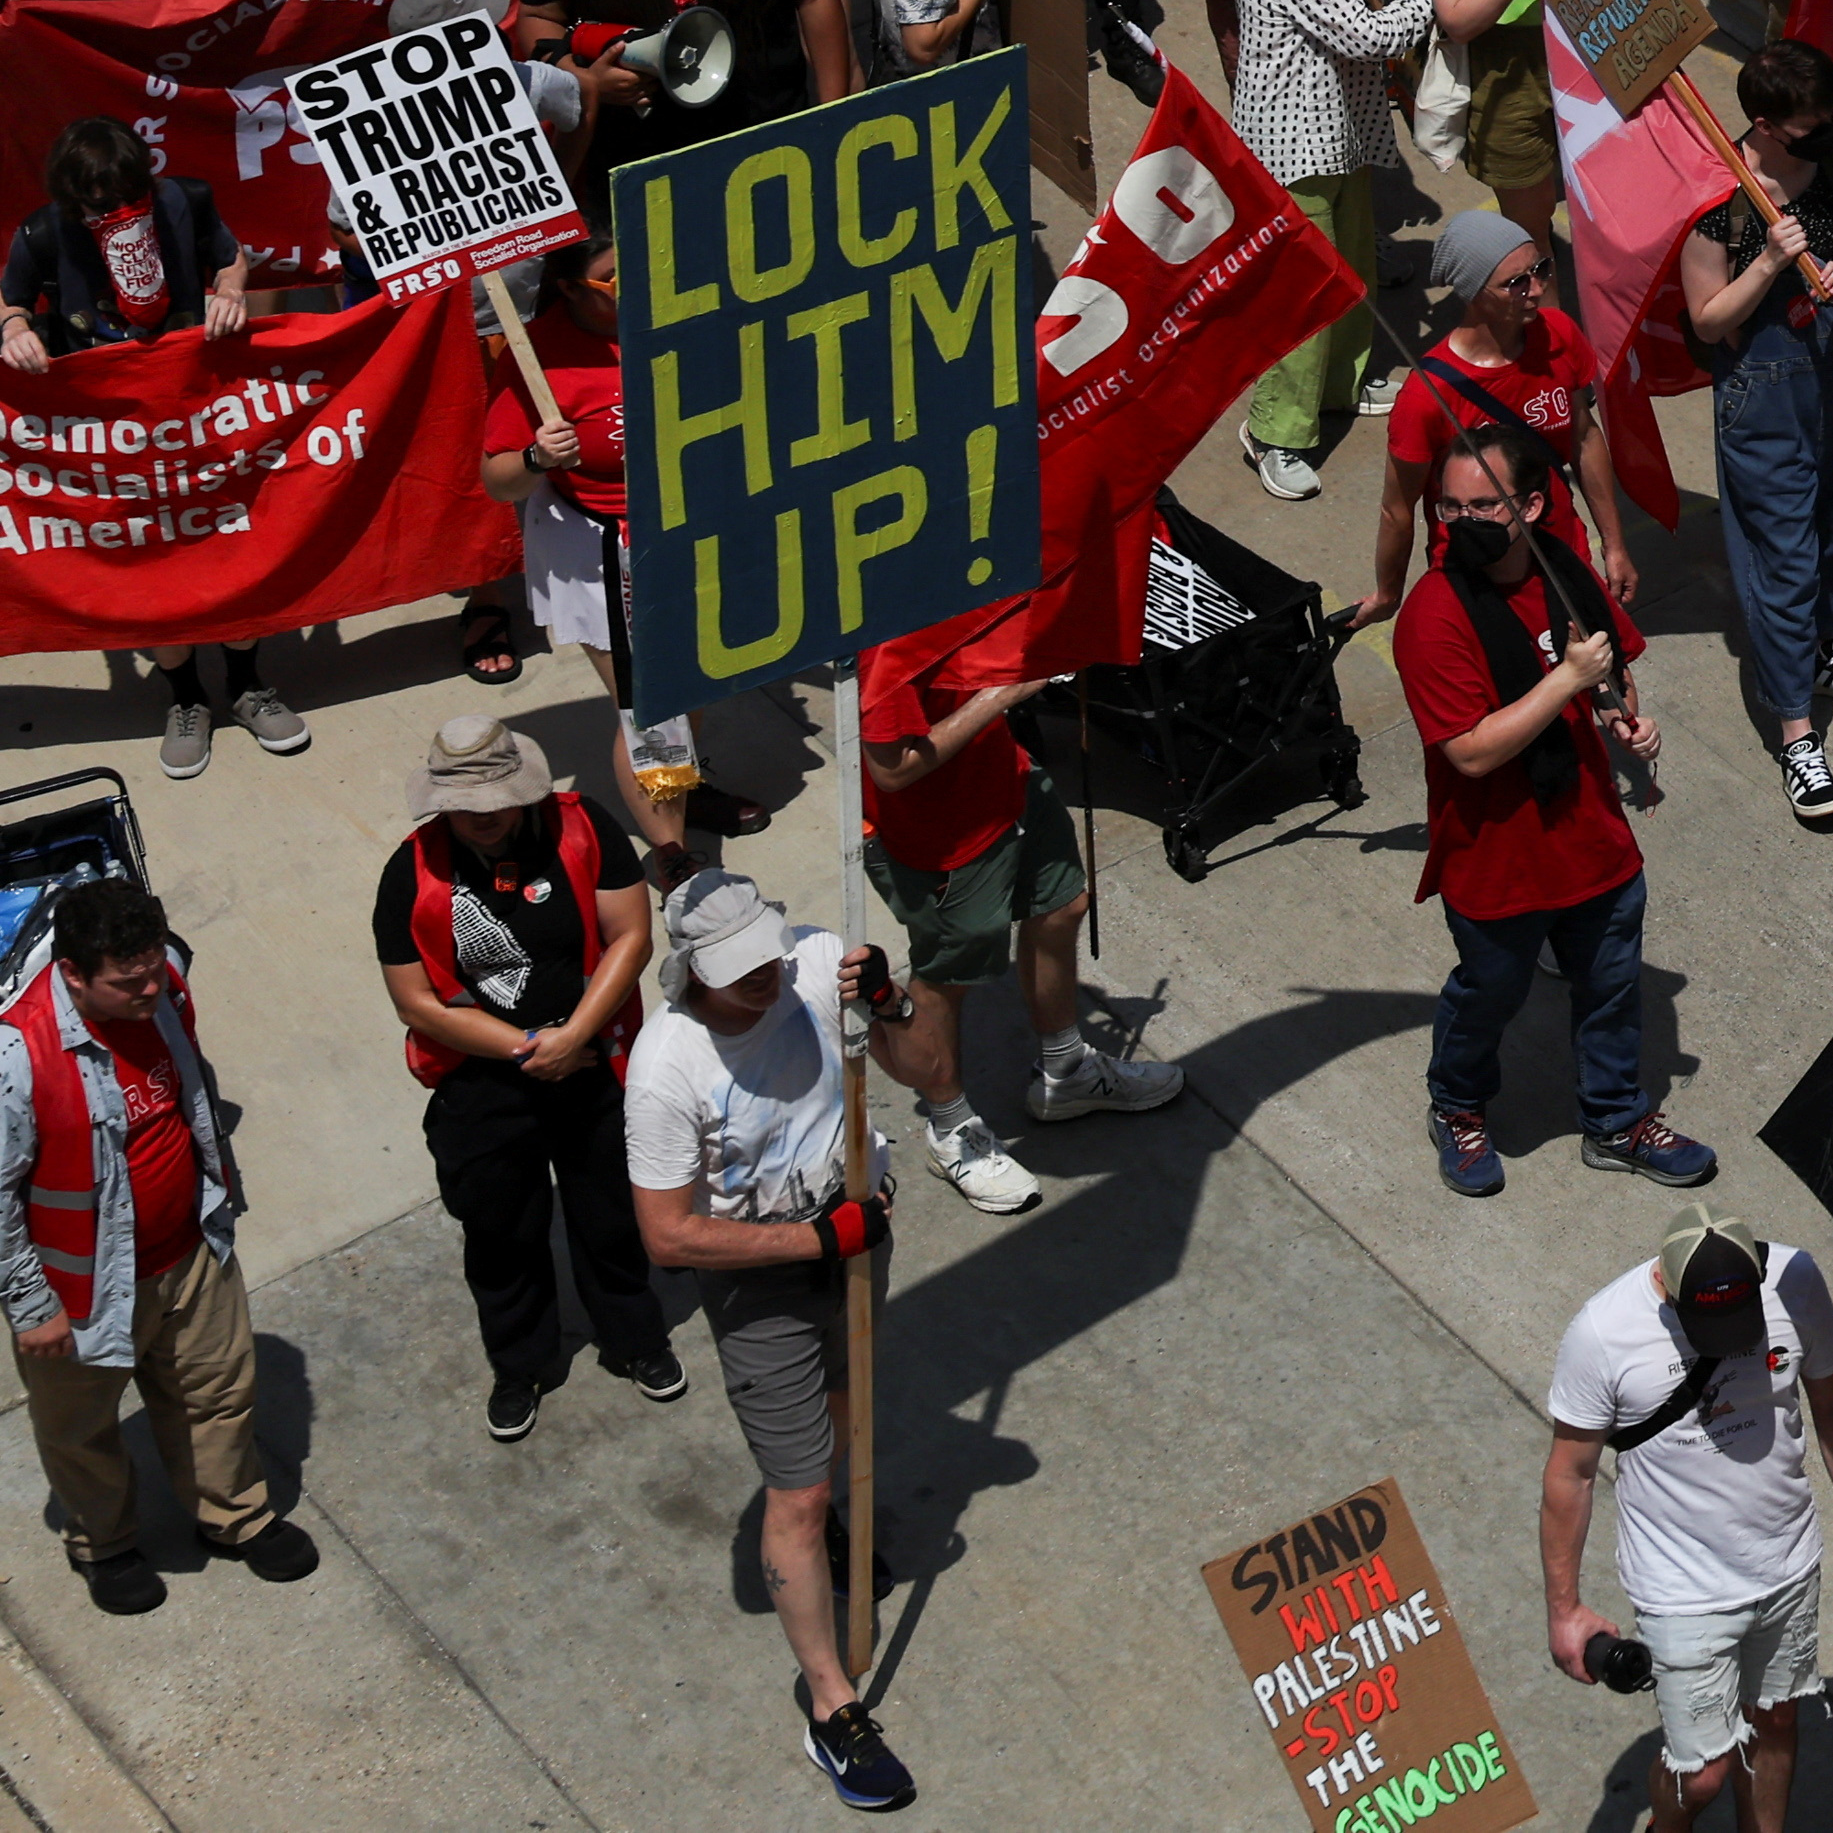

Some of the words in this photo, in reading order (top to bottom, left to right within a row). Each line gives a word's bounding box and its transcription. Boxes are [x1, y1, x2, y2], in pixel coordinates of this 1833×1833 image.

[644, 83, 1014, 332] LOCK
[650, 235, 1020, 532] HIM
[692, 422, 998, 682] UP!
[1231, 1498, 1388, 1614] STAND
[1279, 1555, 1400, 1655] WITH
[1254, 1588, 1441, 1728] PALESTINE
[1307, 1732, 1386, 1806] THE
